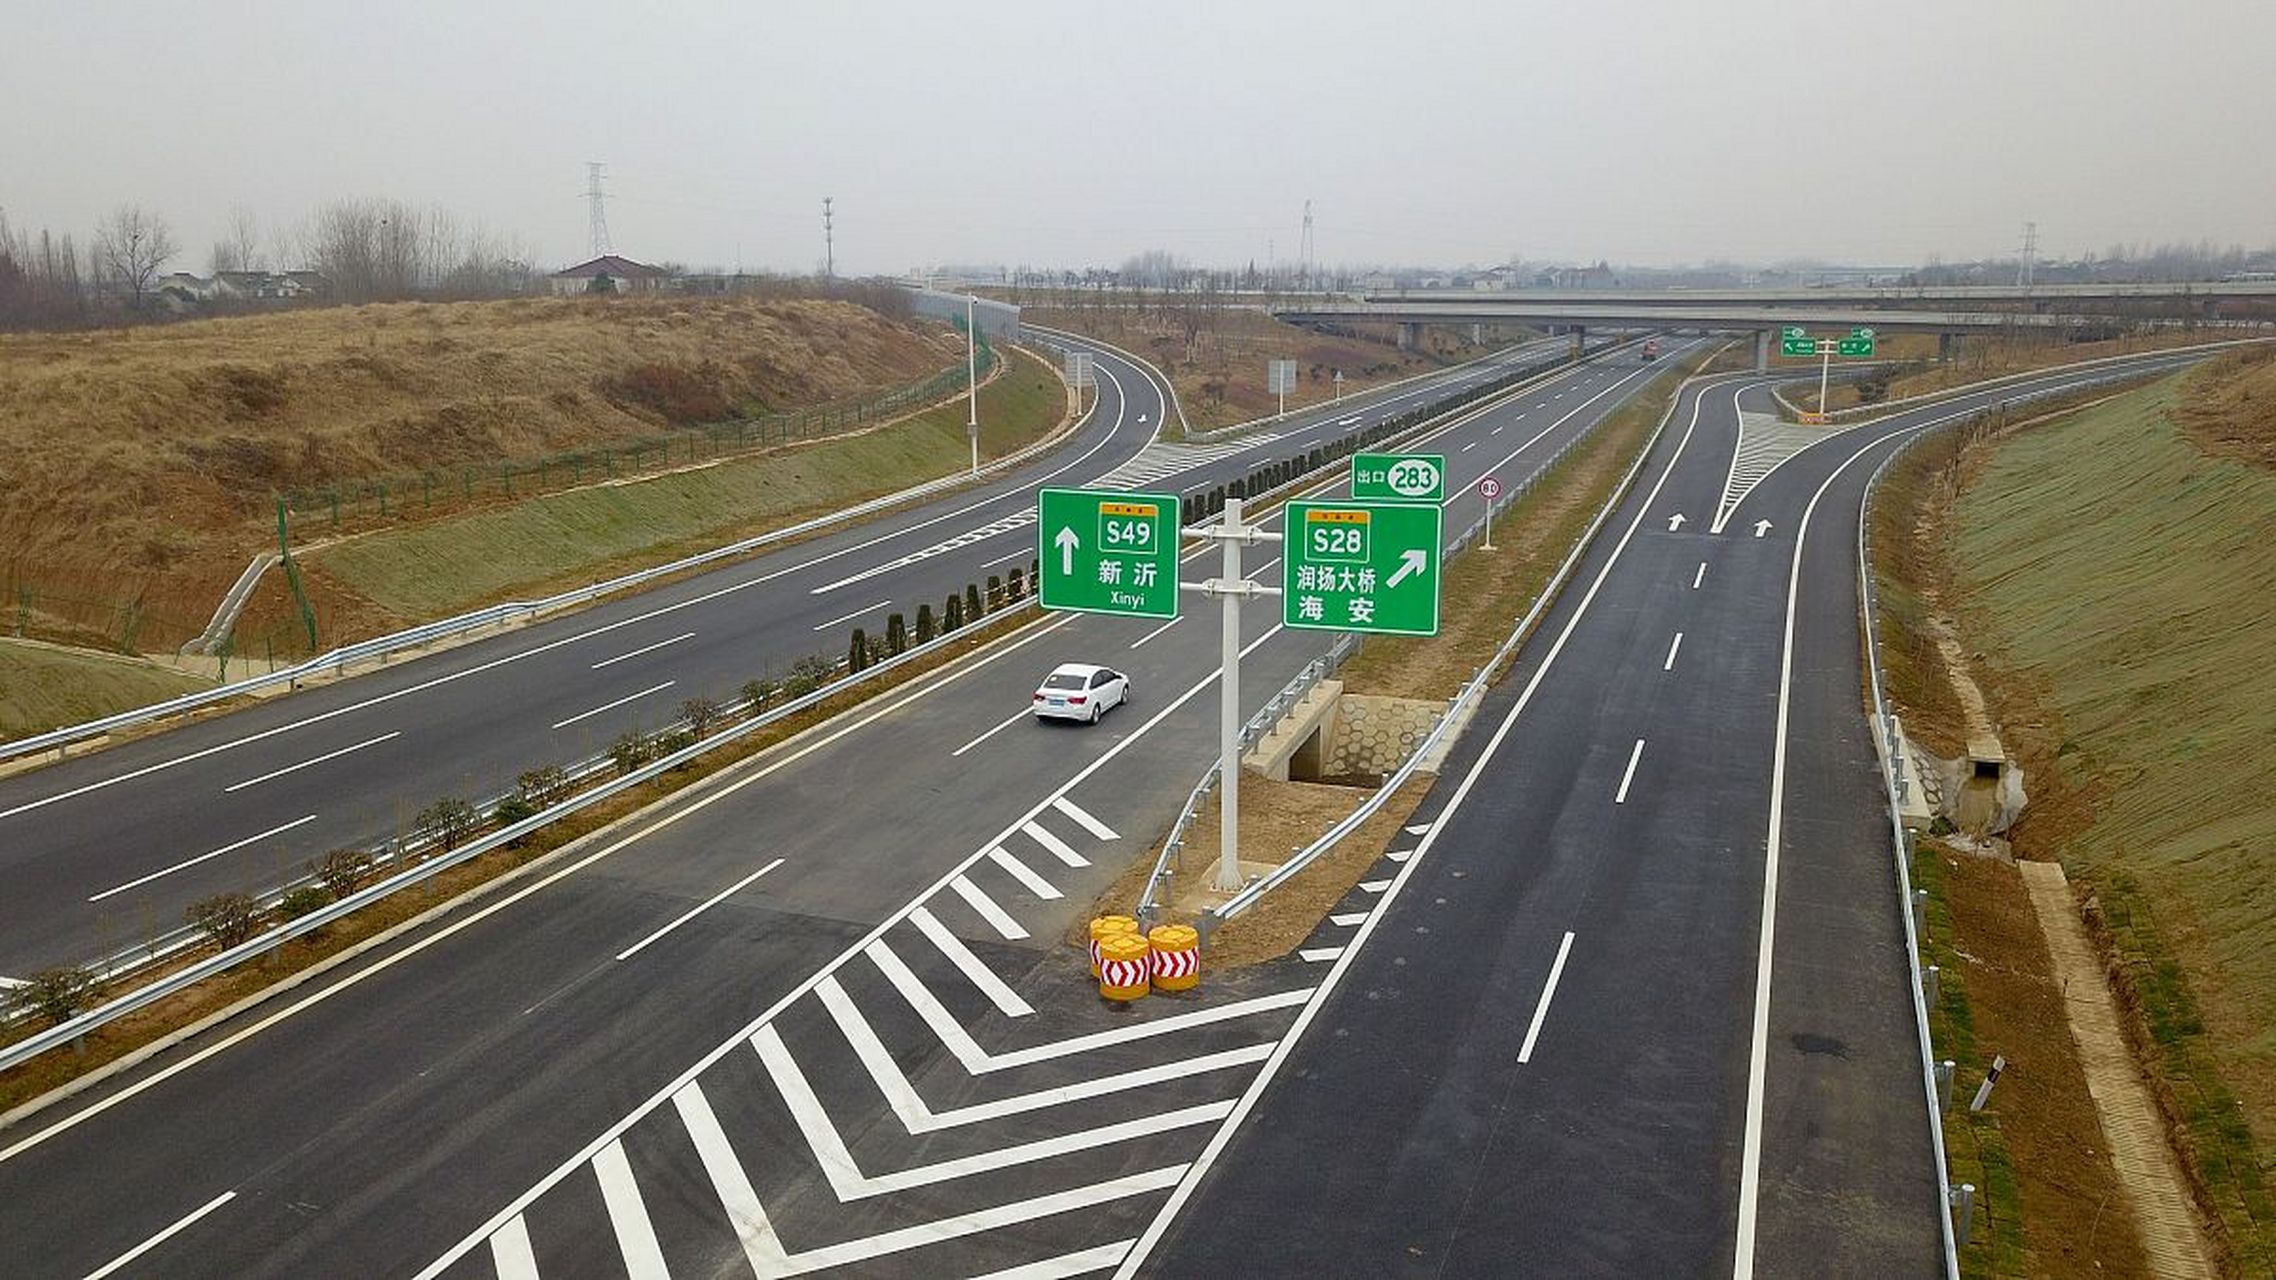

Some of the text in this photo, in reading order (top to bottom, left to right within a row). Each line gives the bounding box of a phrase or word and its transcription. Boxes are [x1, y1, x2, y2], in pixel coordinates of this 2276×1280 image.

[1357, 467, 1432, 488] 出口 283
[1107, 520, 1150, 545] S49
[1313, 528, 1361, 553] S28
[1098, 559, 1157, 587] 新沂
[1297, 565, 1376, 593] 润扬大桥
[1110, 590, 1145, 609] Xinyi
[1298, 595, 1375, 623] 海安
